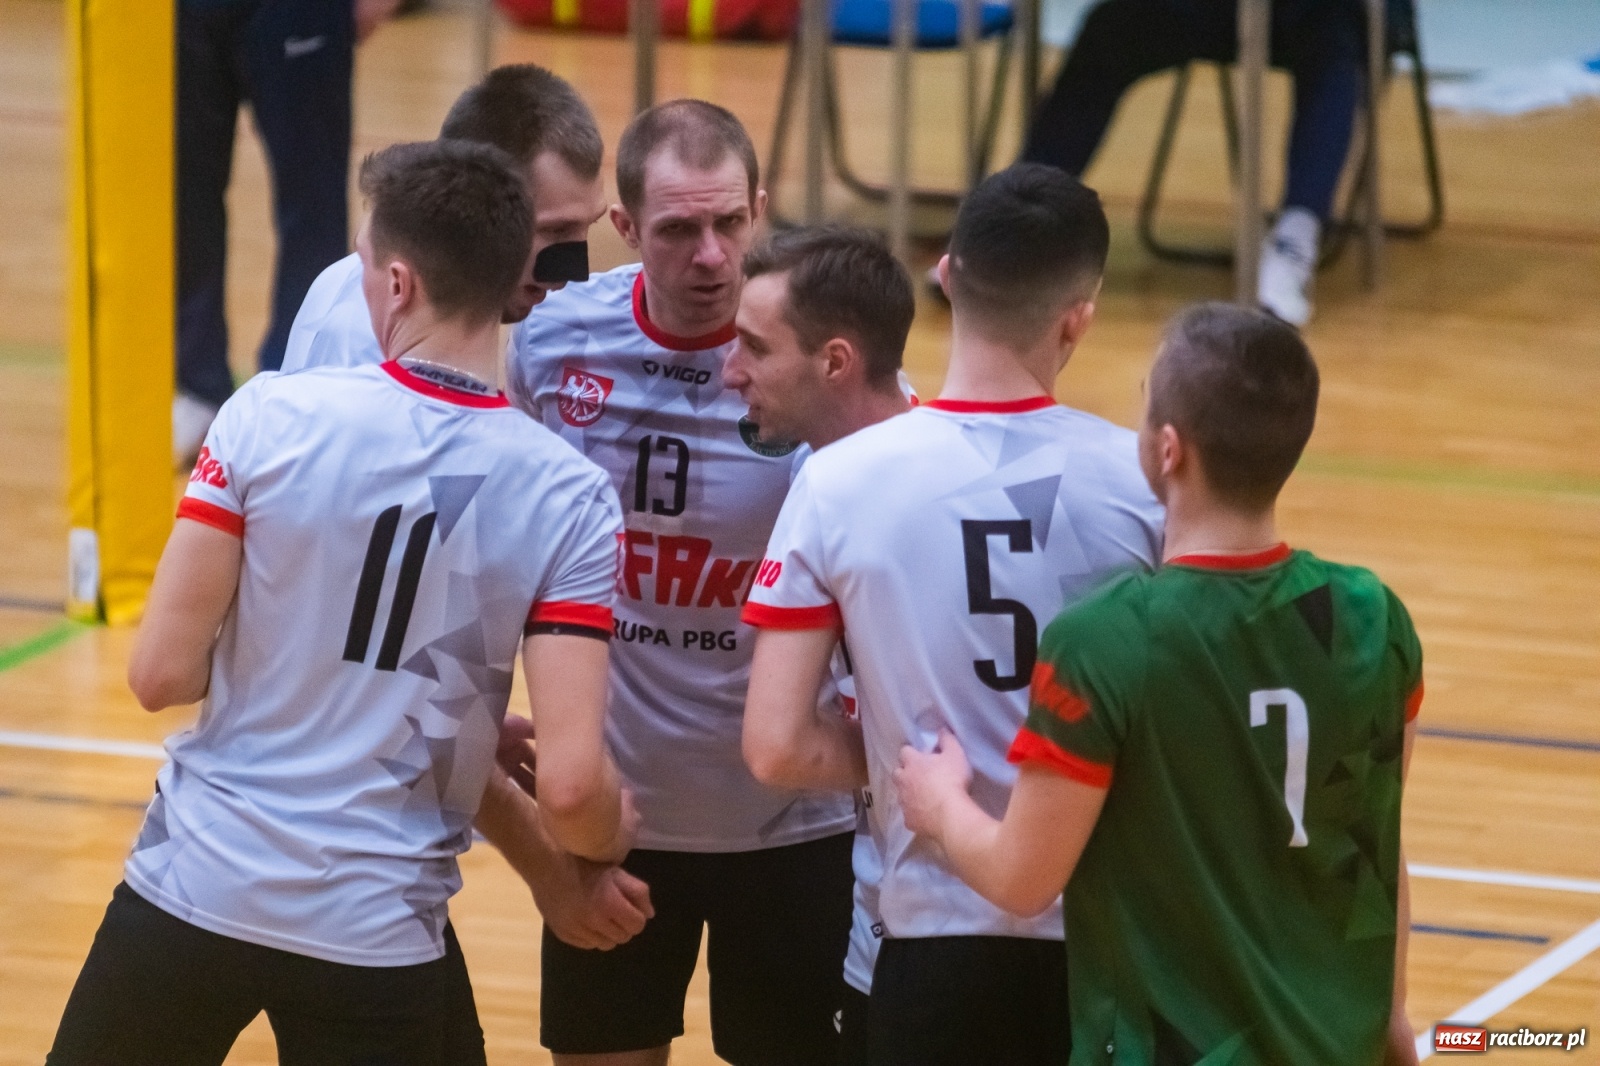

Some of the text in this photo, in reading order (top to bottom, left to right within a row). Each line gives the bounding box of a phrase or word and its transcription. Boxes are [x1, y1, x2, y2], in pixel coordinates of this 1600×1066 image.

[634, 434, 690, 517] 13
[342, 504, 438, 671] 11
[683, 629, 737, 651] PBG
[961, 519, 1038, 692] 5
[1249, 688, 1310, 848] 7
